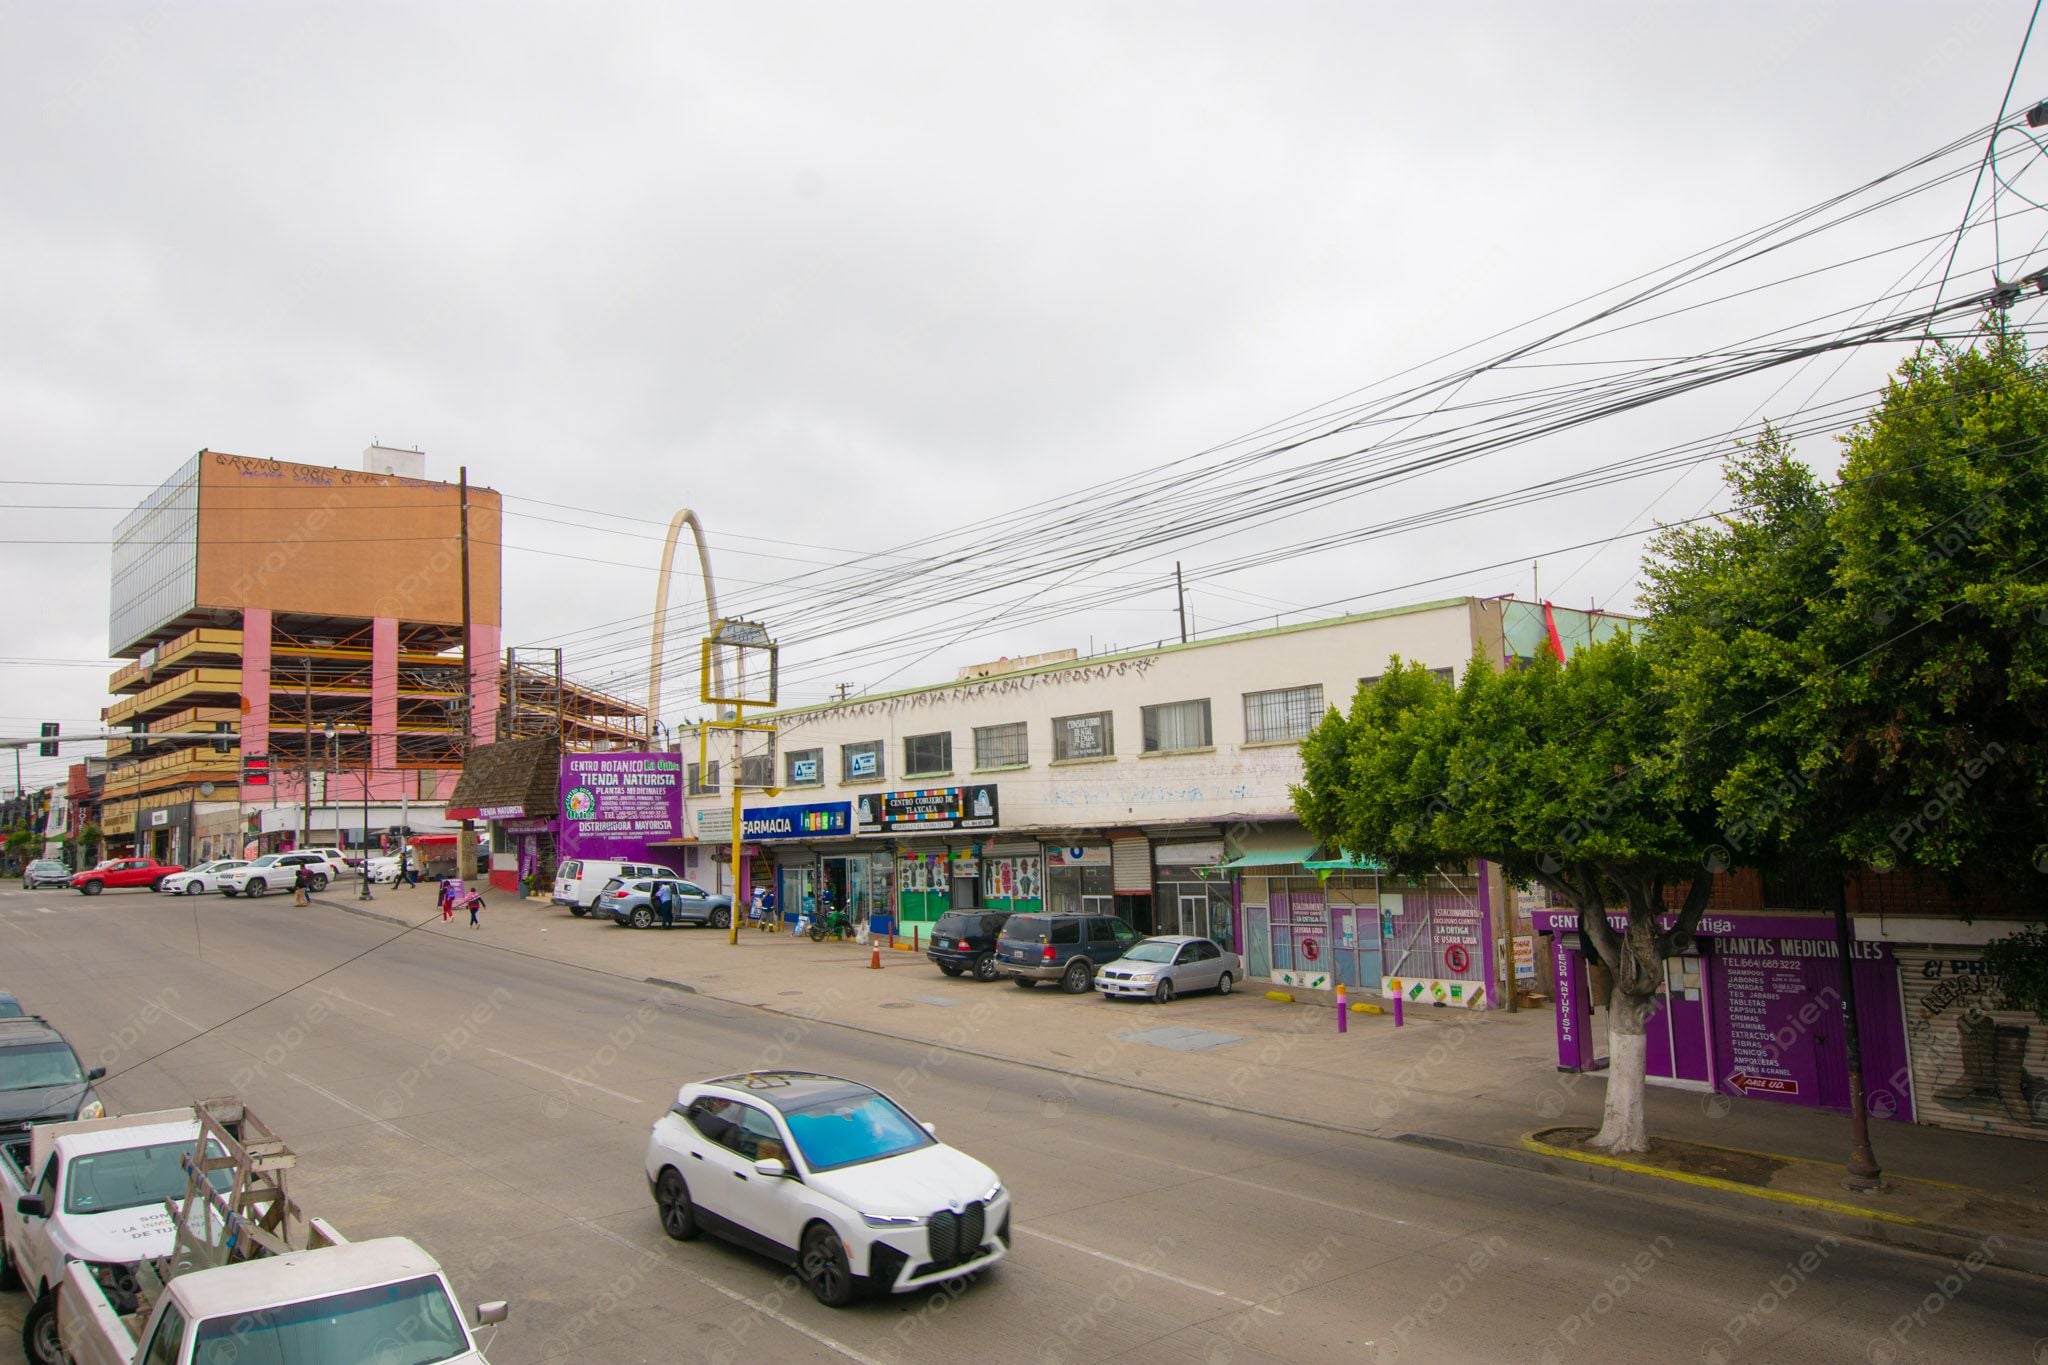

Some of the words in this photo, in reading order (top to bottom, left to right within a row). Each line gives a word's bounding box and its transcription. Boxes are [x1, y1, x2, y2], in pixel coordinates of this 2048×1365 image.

[571, 761, 598, 771] CENTRO
[601, 760, 642, 772] BOTANICO
[580, 774, 618, 785] TIENDA
[624, 774, 675, 785] NATURISTA
[596, 787, 625, 795] PLANTAS
[627, 787, 666, 795] MEDICINALES
[891, 798, 913, 807] CENTRO
[916, 796, 944, 805] COBIJERO
[945, 795, 953, 803] DE
[480, 808, 496, 816] TIENDA
[497, 806, 523, 815] NATURISTA
[906, 804, 937, 814] TLAXCALA
[579, 821, 632, 832] DISTRIBUIDORA
[635, 820, 672, 831] MAYORISTA
[743, 819, 792, 835] FARMACIA
[1549, 915, 1579, 928] CENT
[1696, 917, 1732, 934] rtiga
[1437, 926, 1445, 934] LA
[1446, 926, 1468, 935] ORTIGA
[1441, 936, 1461, 944] USARA
[1462, 937, 1477, 945] GRUA
[1714, 938, 1775, 956] PLANTAS
[1556, 944, 1567, 977] TIENDA
[1728, 977, 1764, 985] JABONES
[1728, 984, 1764, 992] POMADAS
[1729, 998, 1766, 1007] TABLETAS
[1560, 981, 1572, 1043] NATURISTA
[1729, 1006, 1767, 1015] CAPSULAS
[1730, 1015, 1759, 1023] CREMAS
[1731, 1022, 1766, 1031] VITAMINAS
[1731, 1030, 1776, 1042] EXTRACTOS
[1732, 1040, 1762, 1048] FIBRAS
[1733, 1048, 1768, 1057] TONICOS
[1734, 1057, 1780, 1067] AMPOLLETAS
[122, 1226, 138, 1234] LA
[132, 1230, 152, 1239] DE
